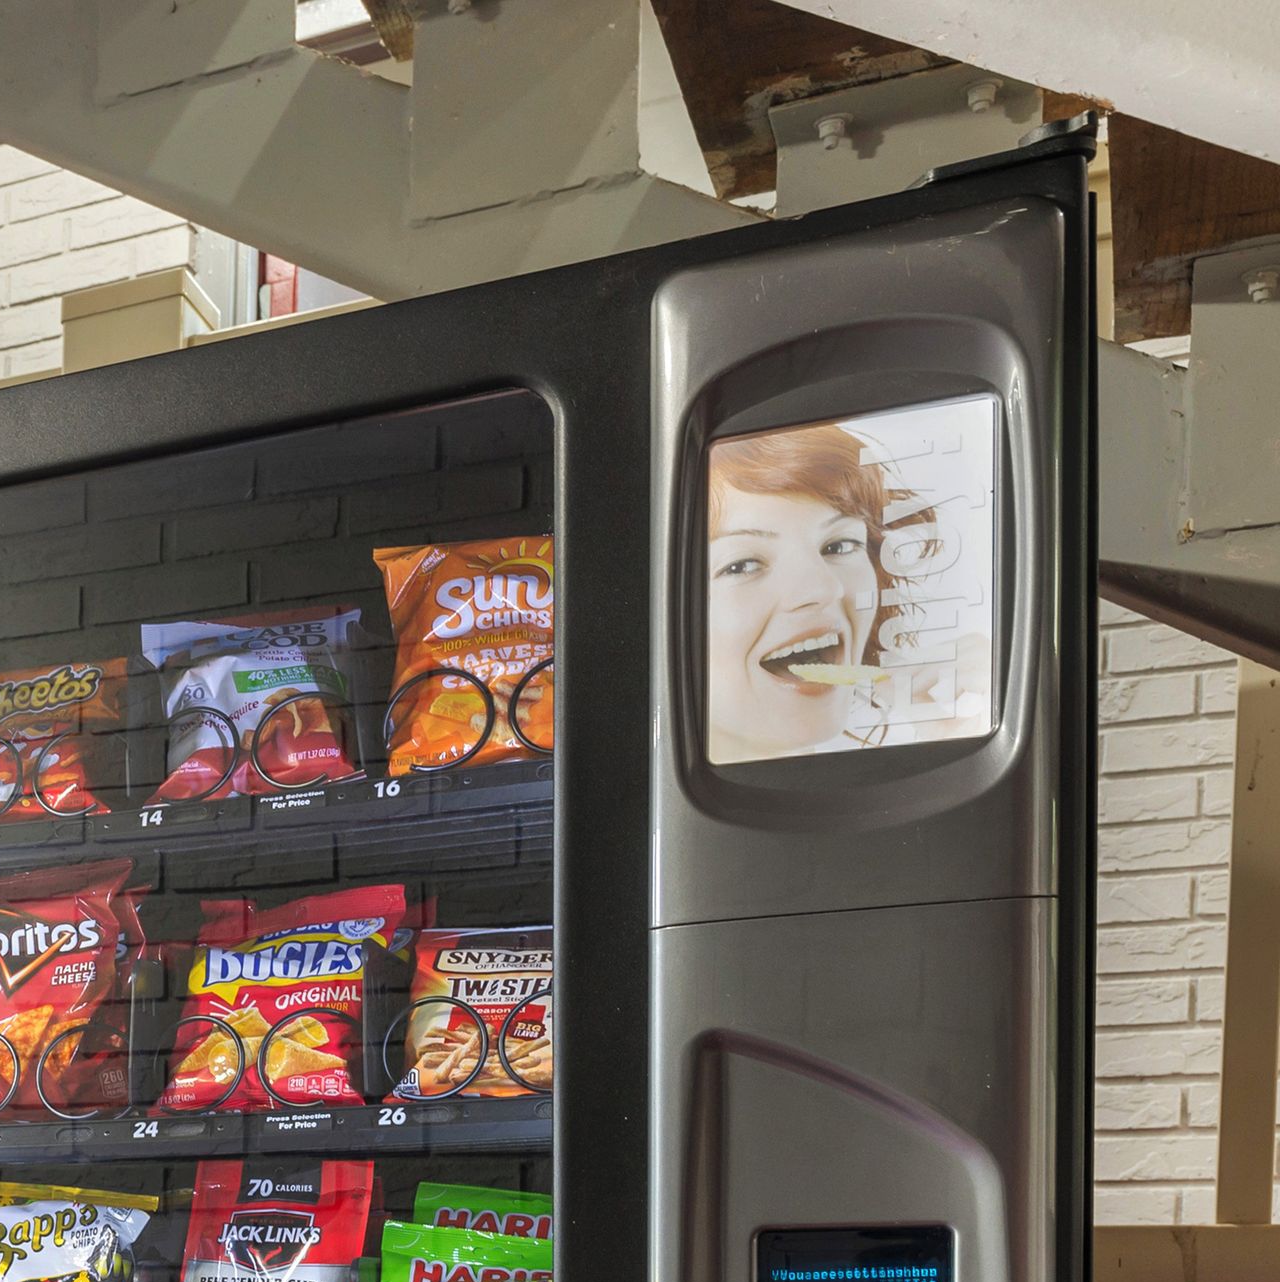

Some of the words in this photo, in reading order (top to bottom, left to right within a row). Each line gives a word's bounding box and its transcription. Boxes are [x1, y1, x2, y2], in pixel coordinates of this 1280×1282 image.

[433, 574, 554, 638] Sun
[475, 611, 552, 631] CHIPS
[241, 634, 327, 650] COD
[374, 780, 401, 798] 16
[139, 810, 163, 827] 14
[54, 961, 96, 974] NACHO
[203, 941, 363, 988] BUGLES
[51, 970, 96, 985] CHEESE
[517, 1021, 542, 1031] BIG
[378, 1107, 406, 1126] 26
[133, 1121, 159, 1138] 24
[247, 1178, 273, 1197] 70
[275, 1183, 313, 1193] CALORIES
[71, 1226, 98, 1239] POTATO
[217, 1223, 263, 1245] JACK
[265, 1223, 322, 1245] LINK'S
